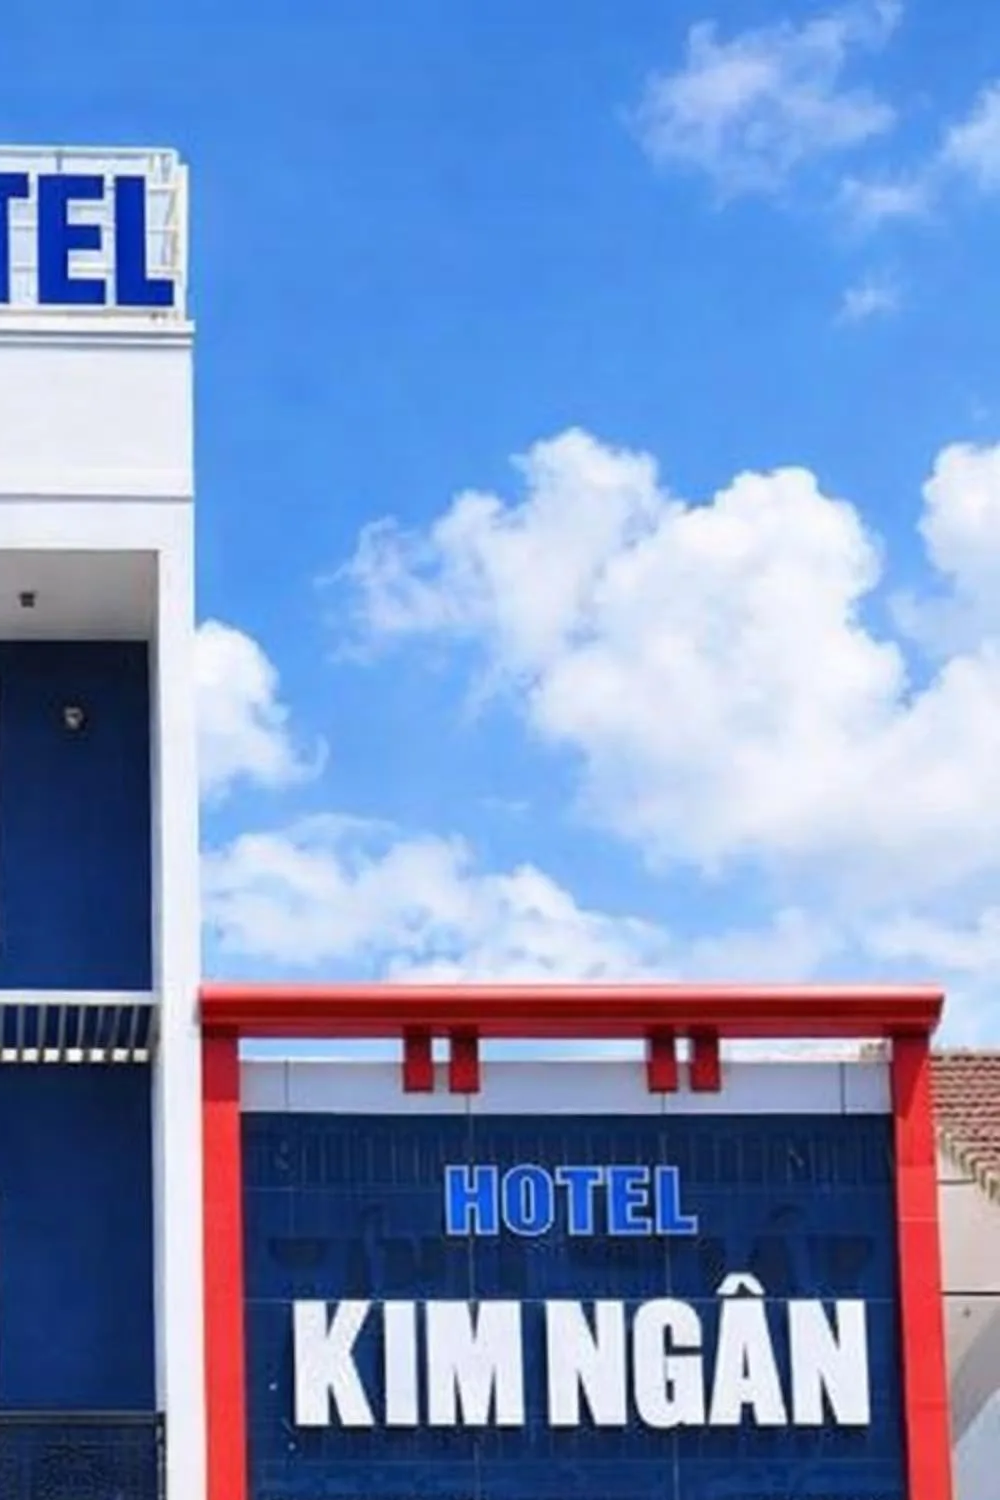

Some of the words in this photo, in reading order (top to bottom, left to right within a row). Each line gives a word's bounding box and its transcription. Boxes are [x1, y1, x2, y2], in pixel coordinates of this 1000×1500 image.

[444, 1164, 699, 1236] HOTEL
[292, 1298, 526, 1427] KIM
[545, 1271, 871, 1430] NGÂN
